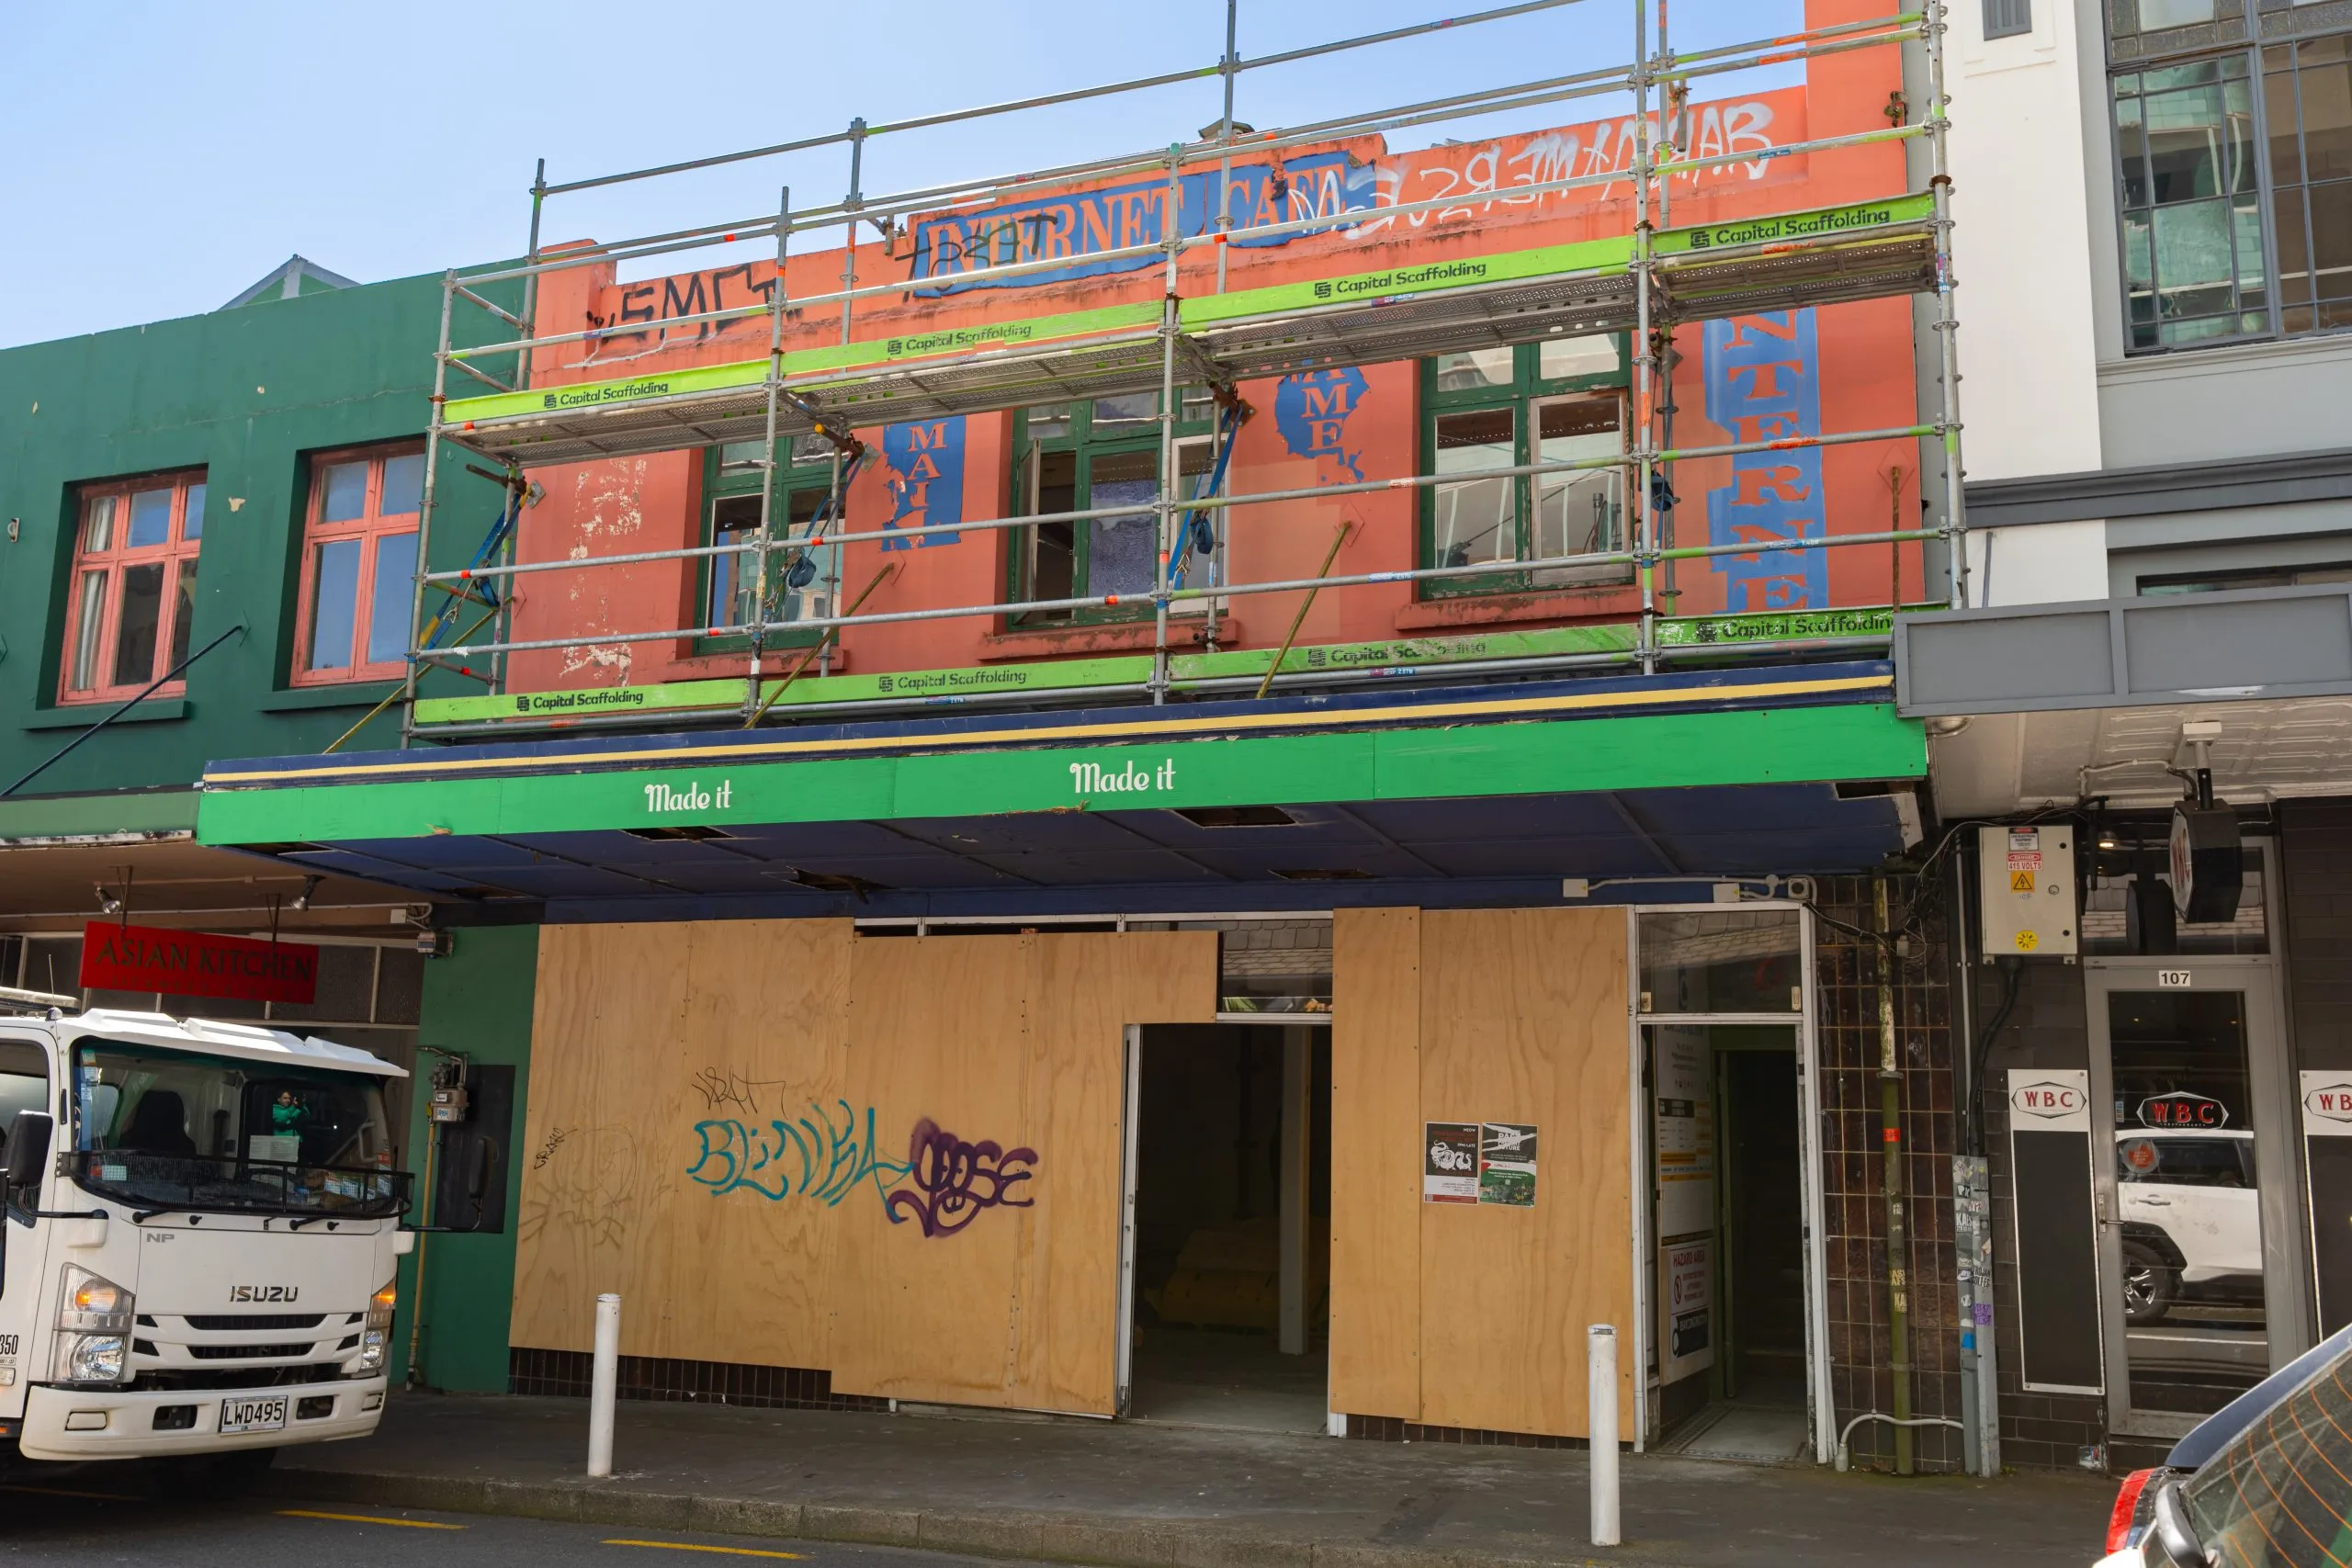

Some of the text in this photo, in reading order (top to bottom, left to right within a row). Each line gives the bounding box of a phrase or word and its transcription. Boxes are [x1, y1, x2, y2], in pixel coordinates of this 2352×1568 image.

[1716, 209, 1891, 243] Capital Scaffolding
[1337, 263, 1487, 293] Capital Scaffolding
[905, 323, 1032, 351] Capital Scaffolding
[560, 381, 669, 405] Capital Scaffolding
[1723, 621, 1790, 641] Capital
[1330, 646, 1389, 665] Capital
[898, 669, 1027, 694] Capital Scaffolding
[533, 689, 644, 711] Capital Scaffolding
[1069, 758, 1177, 794] Made it
[645, 779, 733, 813] Made it
[2009, 862, 2041, 870] 415 VOLTS
[95, 935, 311, 983] ASIAN KITCHEN
[2161, 973, 2189, 985] 107
[2024, 1090, 2074, 1108] WBC
[2151, 1101, 2214, 1124] WBC
[146, 1233, 175, 1243] NP
[229, 1285, 299, 1303] ISUZU
[223, 1402, 284, 1426] LWD495
